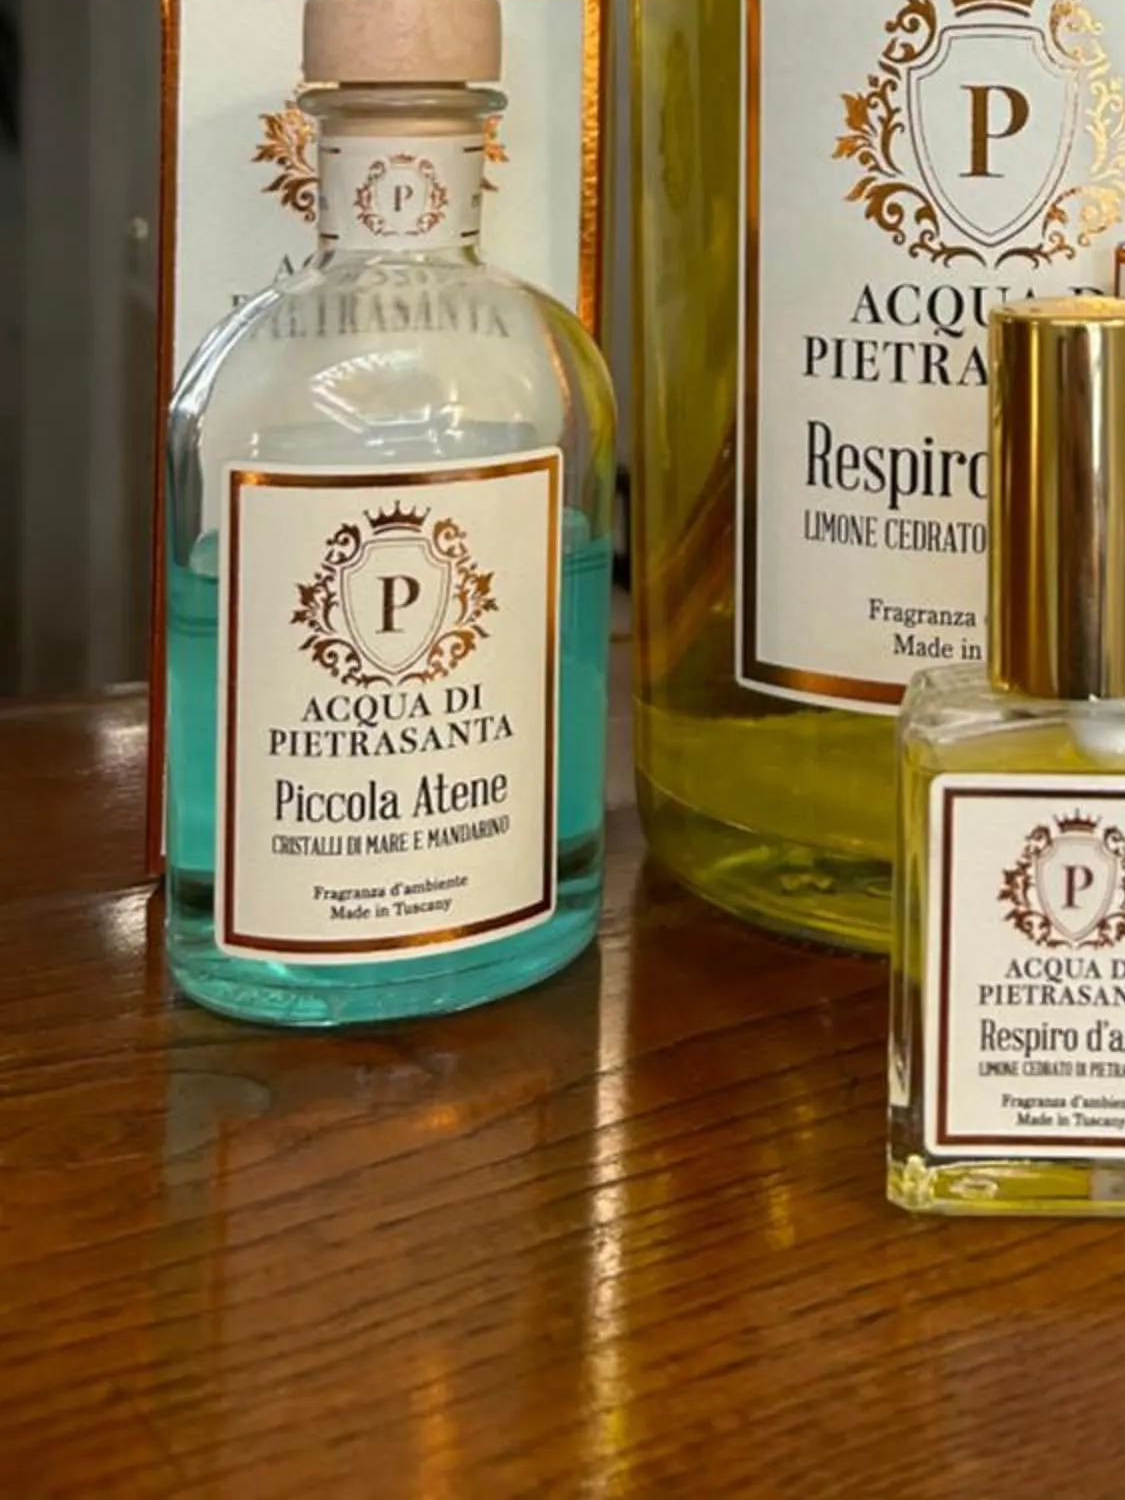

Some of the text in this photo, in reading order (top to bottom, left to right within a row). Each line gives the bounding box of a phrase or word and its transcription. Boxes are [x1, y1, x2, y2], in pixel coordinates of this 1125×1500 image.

[959, 84, 1030, 178] P
[394, 185, 413, 212] P
[850, 283, 1038, 338] ACQU
[803, 509, 986, 554] LIMONE CEDRATO
[376, 575, 420, 634] P
[869, 598, 976, 628] Fragranza
[893, 634, 982, 660] Made in
[302, 683, 483, 727] ACQUA DI
[269, 714, 514, 758] PIETRASANTA
[274, 772, 508, 823] Piccola Atene
[271, 815, 511, 856] CRISTALLI DI MARE E MANDARINO
[313, 874, 468, 903] Fragranza d'ambiente
[1062, 865, 1094, 910] P
[330, 897, 453, 920] Made in Tuscany
[1005, 958, 1102, 985] ACQUA
[979, 1018, 1078, 1057] Respiro
[978, 1061, 1019, 1077] LIMONE
[1022, 1061, 1073, 1077] CEDRATO
[1001, 1094, 1067, 1111] Fragranza
[1016, 1112, 1125, 1130] Made in Tuscany
